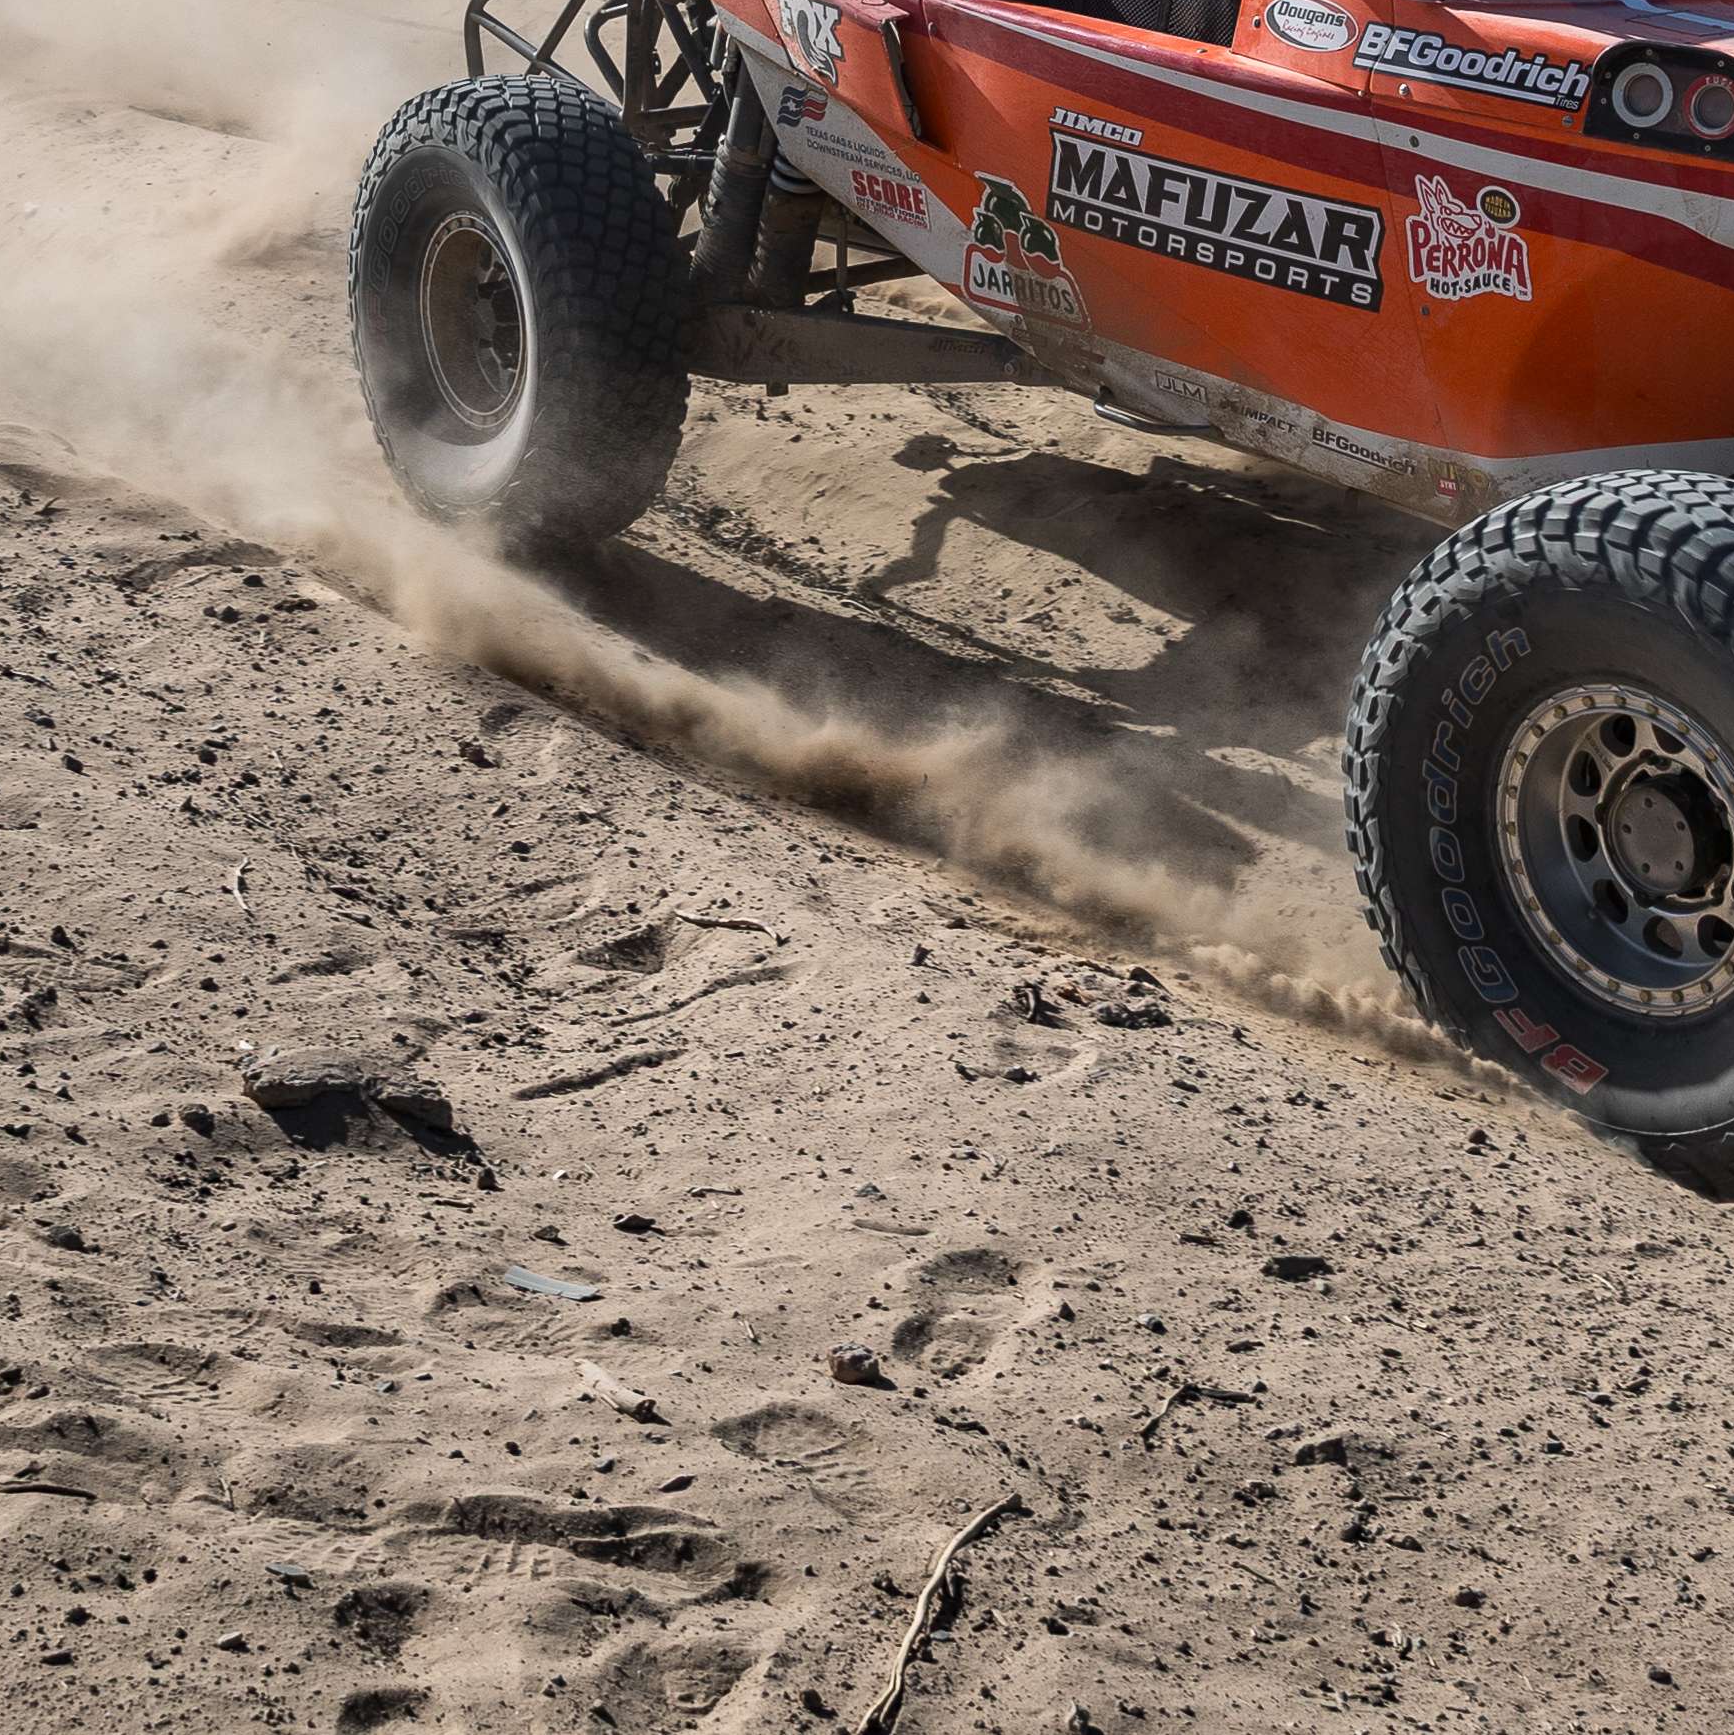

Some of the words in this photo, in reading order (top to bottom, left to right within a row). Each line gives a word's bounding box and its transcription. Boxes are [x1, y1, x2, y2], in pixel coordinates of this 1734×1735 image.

[1278, 0, 1346, 29] Dougans
[1357, 25, 1590, 98] BFGoodrich
[806, 125, 828, 141] TEXAS
[854, 142, 886, 160] LIQUIDS
[1050, 106, 1143, 147] JIMCO
[807, 139, 863, 165] DOWNSTREAM
[851, 169, 927, 216] SCORE
[1056, 134, 1378, 272] MAFUZAR
[1053, 199, 1374, 307] MOTORSPORTS
[1410, 219, 1527, 289] PERRONA
[973, 262, 1076, 315] JARRITOS
[1163, 374, 1203, 402] JLM
[1312, 427, 1416, 475] BFGoodrich
[1421, 624, 1610, 1095] BFGoodrich
